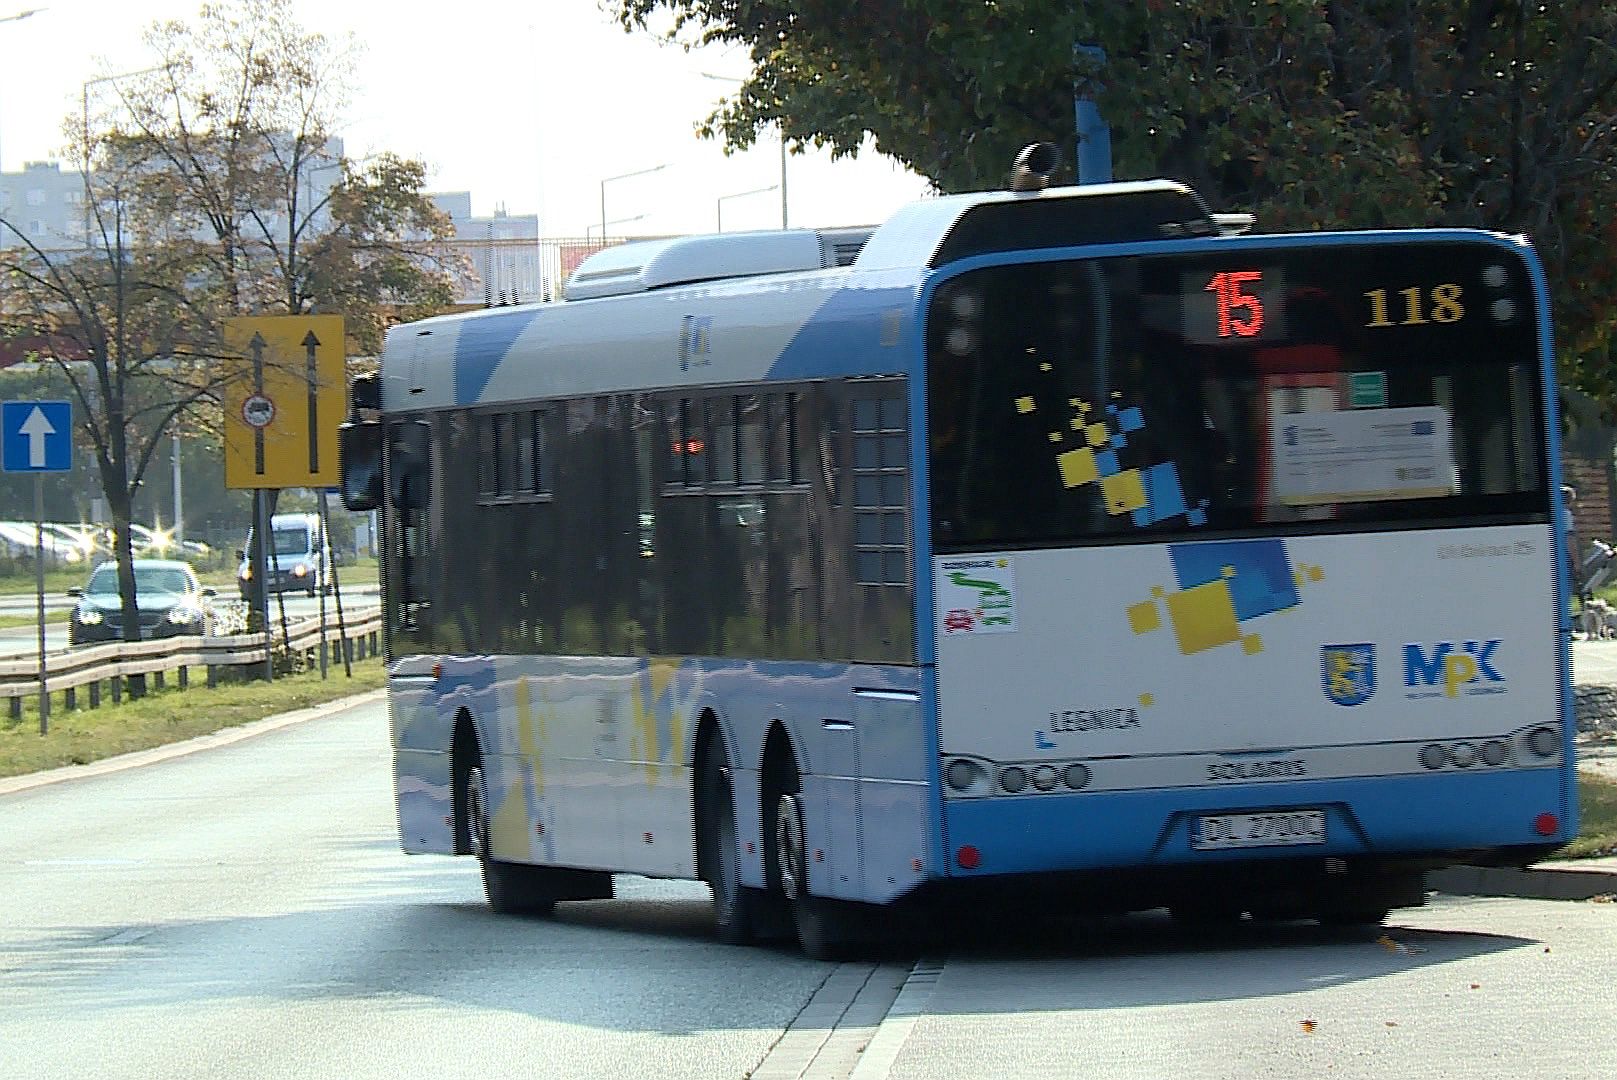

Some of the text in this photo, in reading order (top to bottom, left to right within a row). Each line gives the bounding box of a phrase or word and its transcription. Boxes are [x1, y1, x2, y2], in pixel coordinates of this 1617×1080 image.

[1204, 270, 1265, 338] 15
[1363, 283, 1466, 328] 118
[1049, 707, 1142, 734] LEGNICA
[1206, 759, 1309, 781] SOLARIS
[1204, 818, 1242, 842] DL
